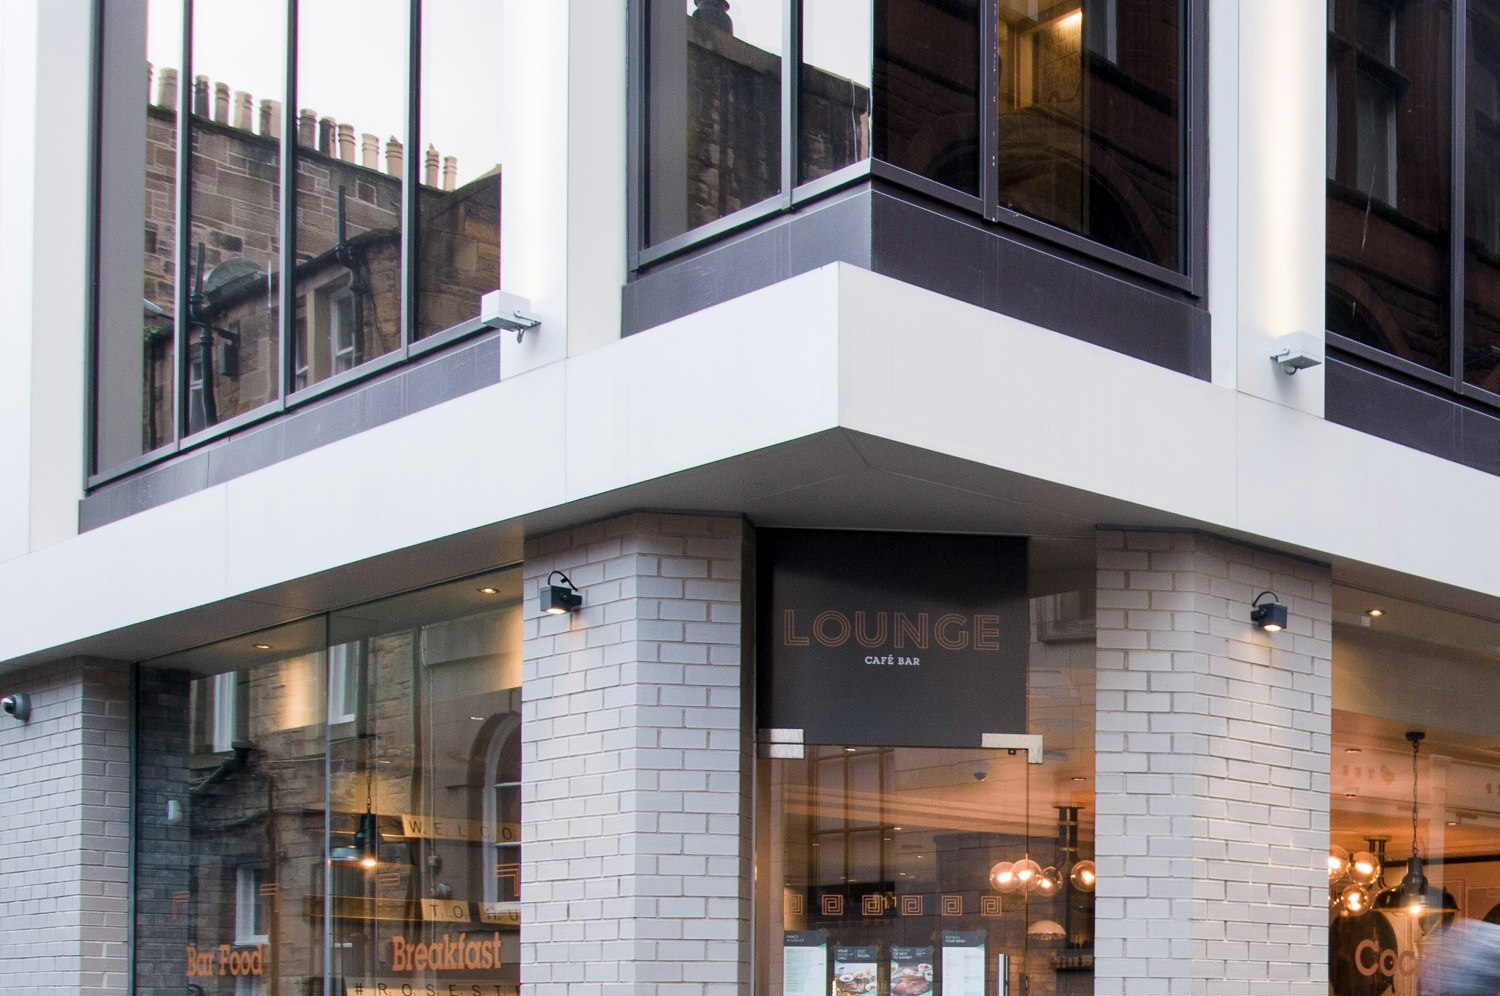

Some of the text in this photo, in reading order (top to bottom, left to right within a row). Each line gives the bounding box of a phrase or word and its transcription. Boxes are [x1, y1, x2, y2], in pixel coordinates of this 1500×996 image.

[784, 609, 1000, 650] LOUNGE
[864, 654, 920, 666] CAFÉ BAR
[429, 904, 464, 919] TO
[186, 943, 263, 976] Bar Food
[391, 931, 502, 971] Breakfast
